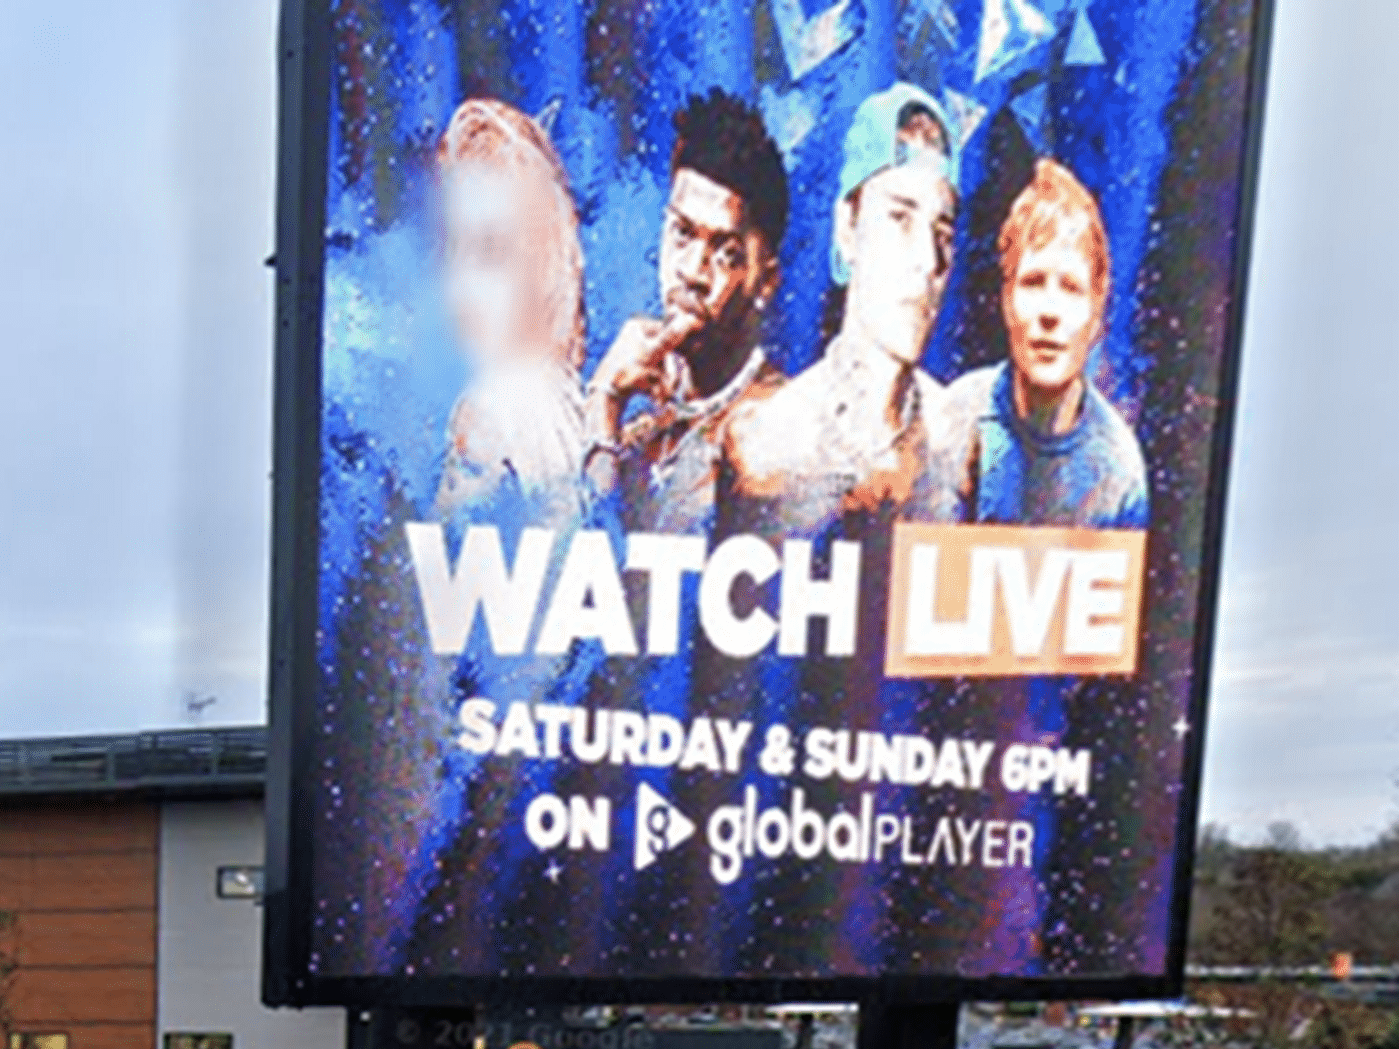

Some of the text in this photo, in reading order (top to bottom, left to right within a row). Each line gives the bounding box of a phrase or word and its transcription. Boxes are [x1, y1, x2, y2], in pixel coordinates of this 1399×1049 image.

[406, 520, 1130, 661] WATCH LIVE
[457, 698, 1091, 797] SATURDAY & SUNDAY 6PM
[525, 795, 611, 852] ON
